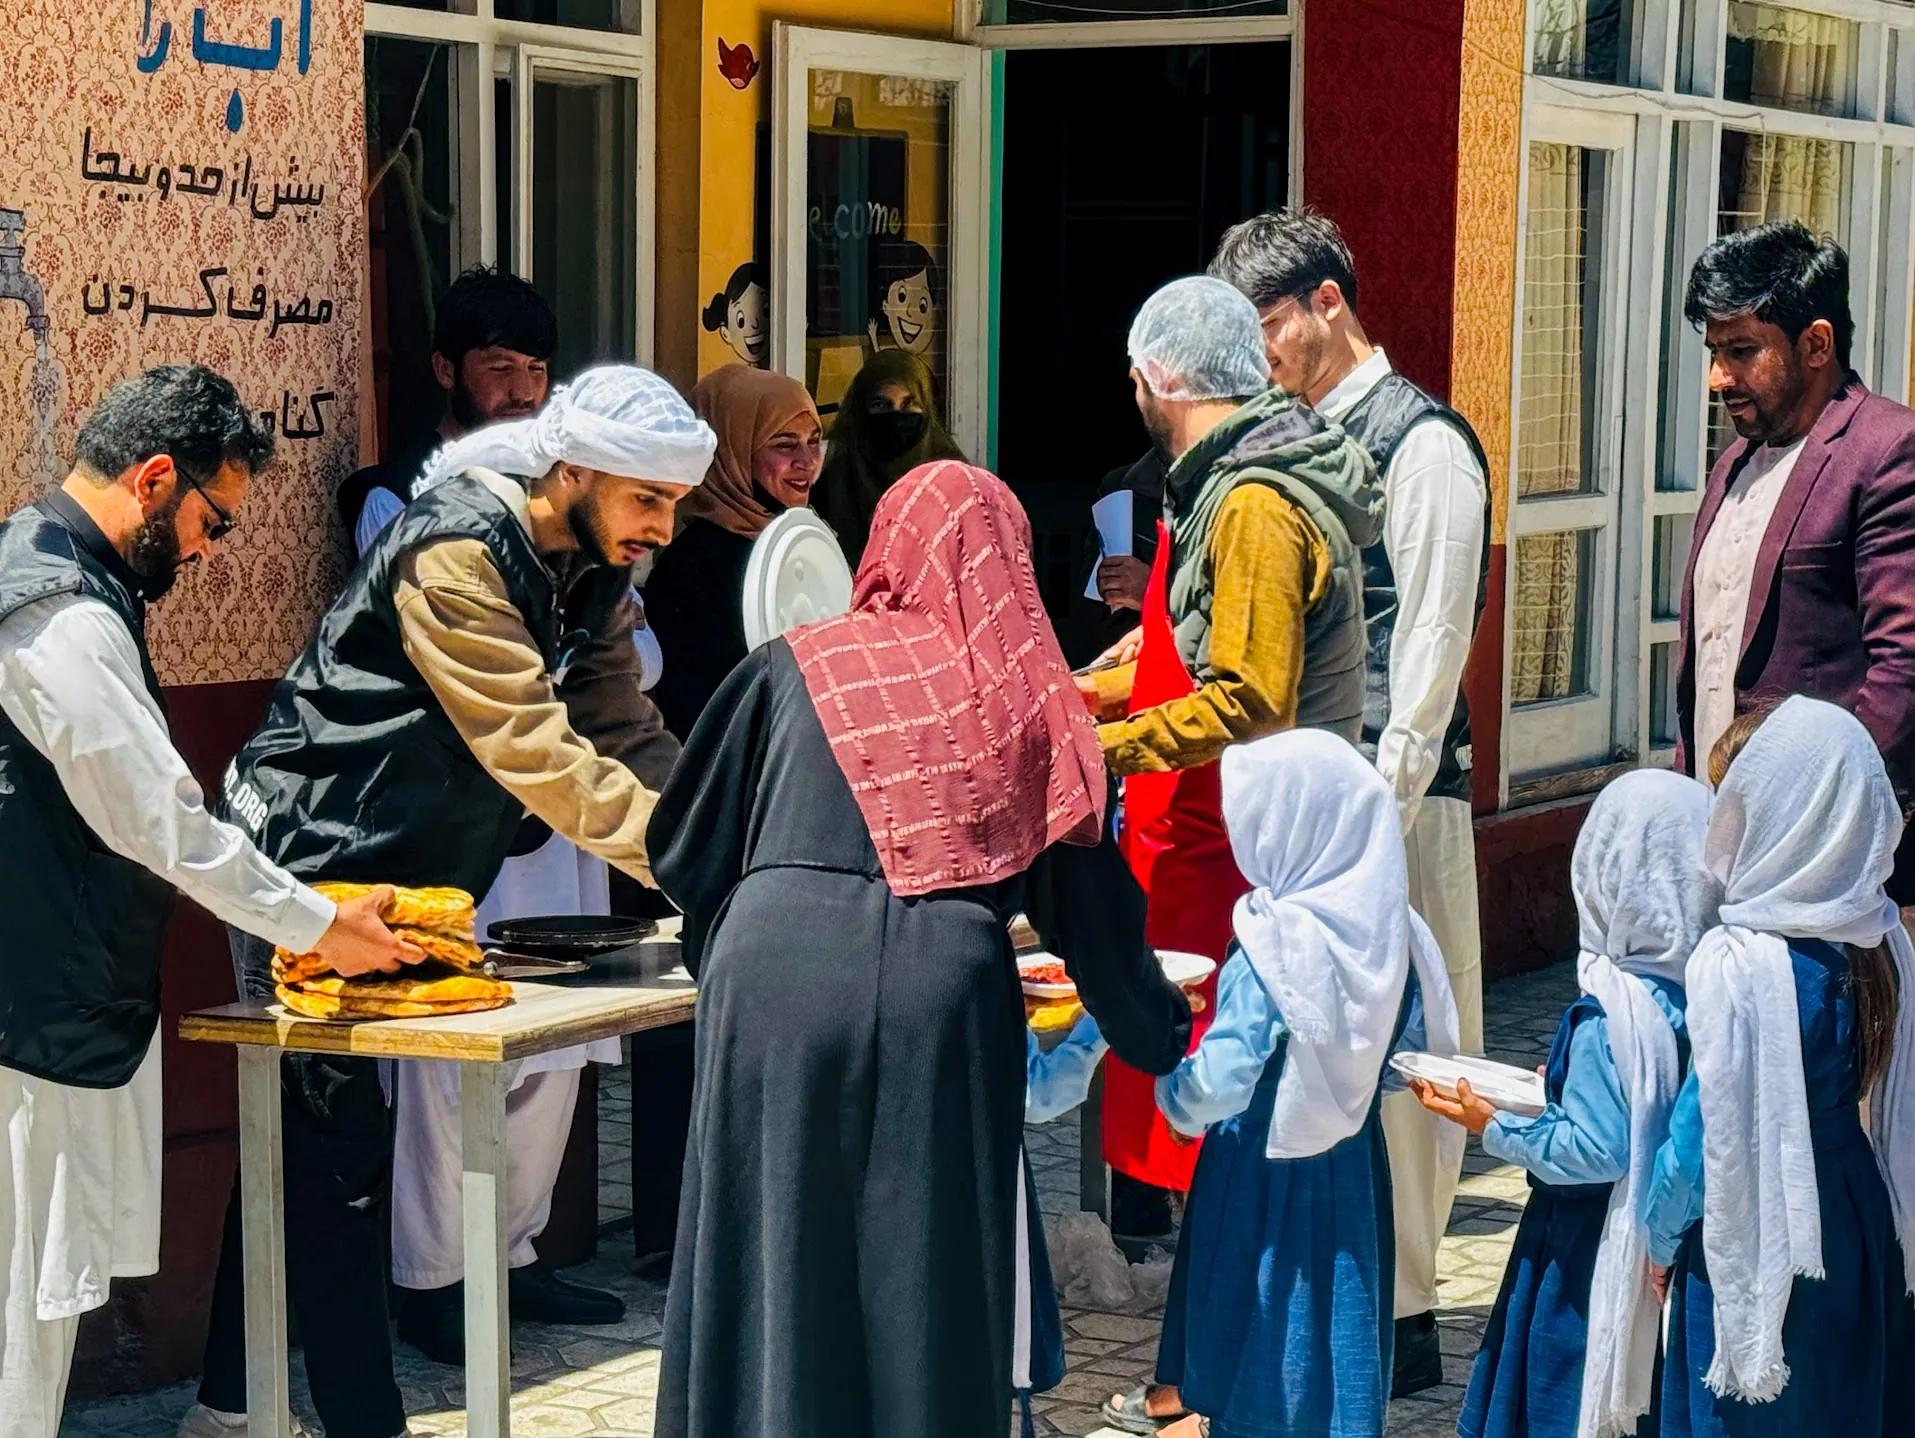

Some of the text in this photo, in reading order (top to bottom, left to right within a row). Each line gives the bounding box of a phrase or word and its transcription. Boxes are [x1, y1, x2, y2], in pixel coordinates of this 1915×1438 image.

[157, 166, 172, 201] و
[175, 164, 224, 197] حد
[230, 155, 252, 207] از
[251, 155, 325, 223] بیش
[82, 266, 334, 338] مصرف کردن
